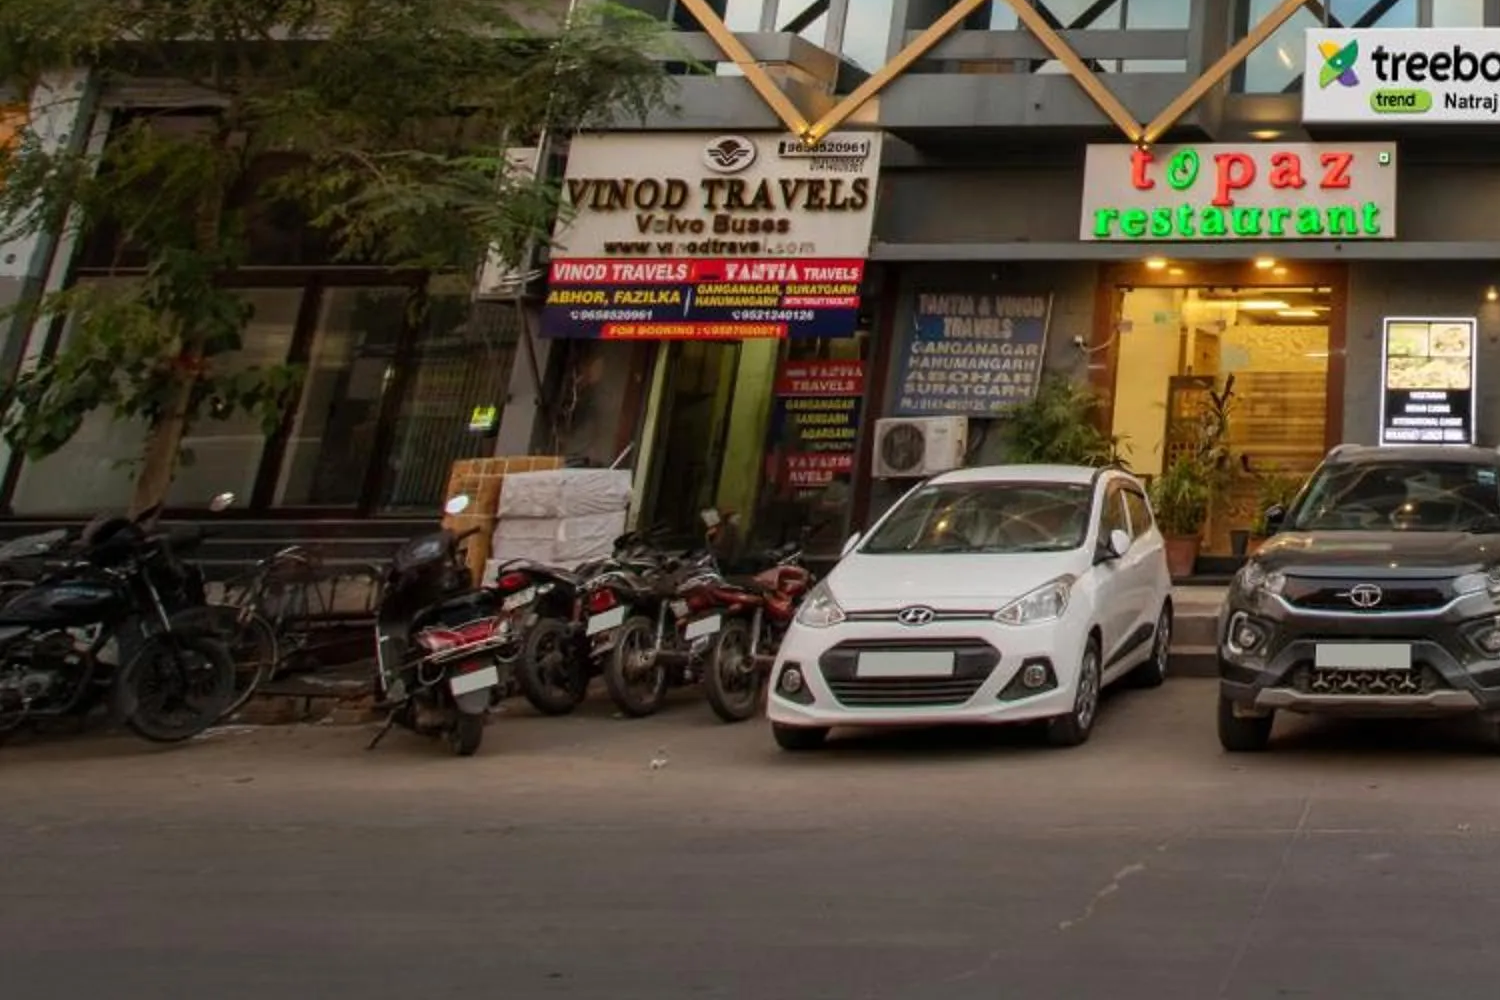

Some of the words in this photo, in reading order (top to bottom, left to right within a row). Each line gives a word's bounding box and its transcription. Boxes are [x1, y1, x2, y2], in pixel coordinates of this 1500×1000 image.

[1375, 91, 1417, 109] trend
[1444, 91, 1499, 113] Natraj
[1130, 147, 1354, 206] topaz
[567, 177, 692, 211] VINOD
[701, 177, 870, 213] TRAVELS
[636, 215, 705, 234] Volvo
[713, 215, 791, 234] Buses
[1093, 201, 1380, 237] restaurant
[553, 263, 607, 281] VINOD
[612, 263, 688, 281] TRAVELS
[803, 268, 859, 281] TRAVELS
[613, 290, 680, 304] FAZILKA
[943, 317, 1012, 339] TRAVELS
[911, 341, 1039, 356] GANGANAGAR
[908, 356, 1036, 370] HANUMANGARH
[906, 371, 1034, 383] ABOHAR
[903, 383, 1031, 396] SURATGARH
